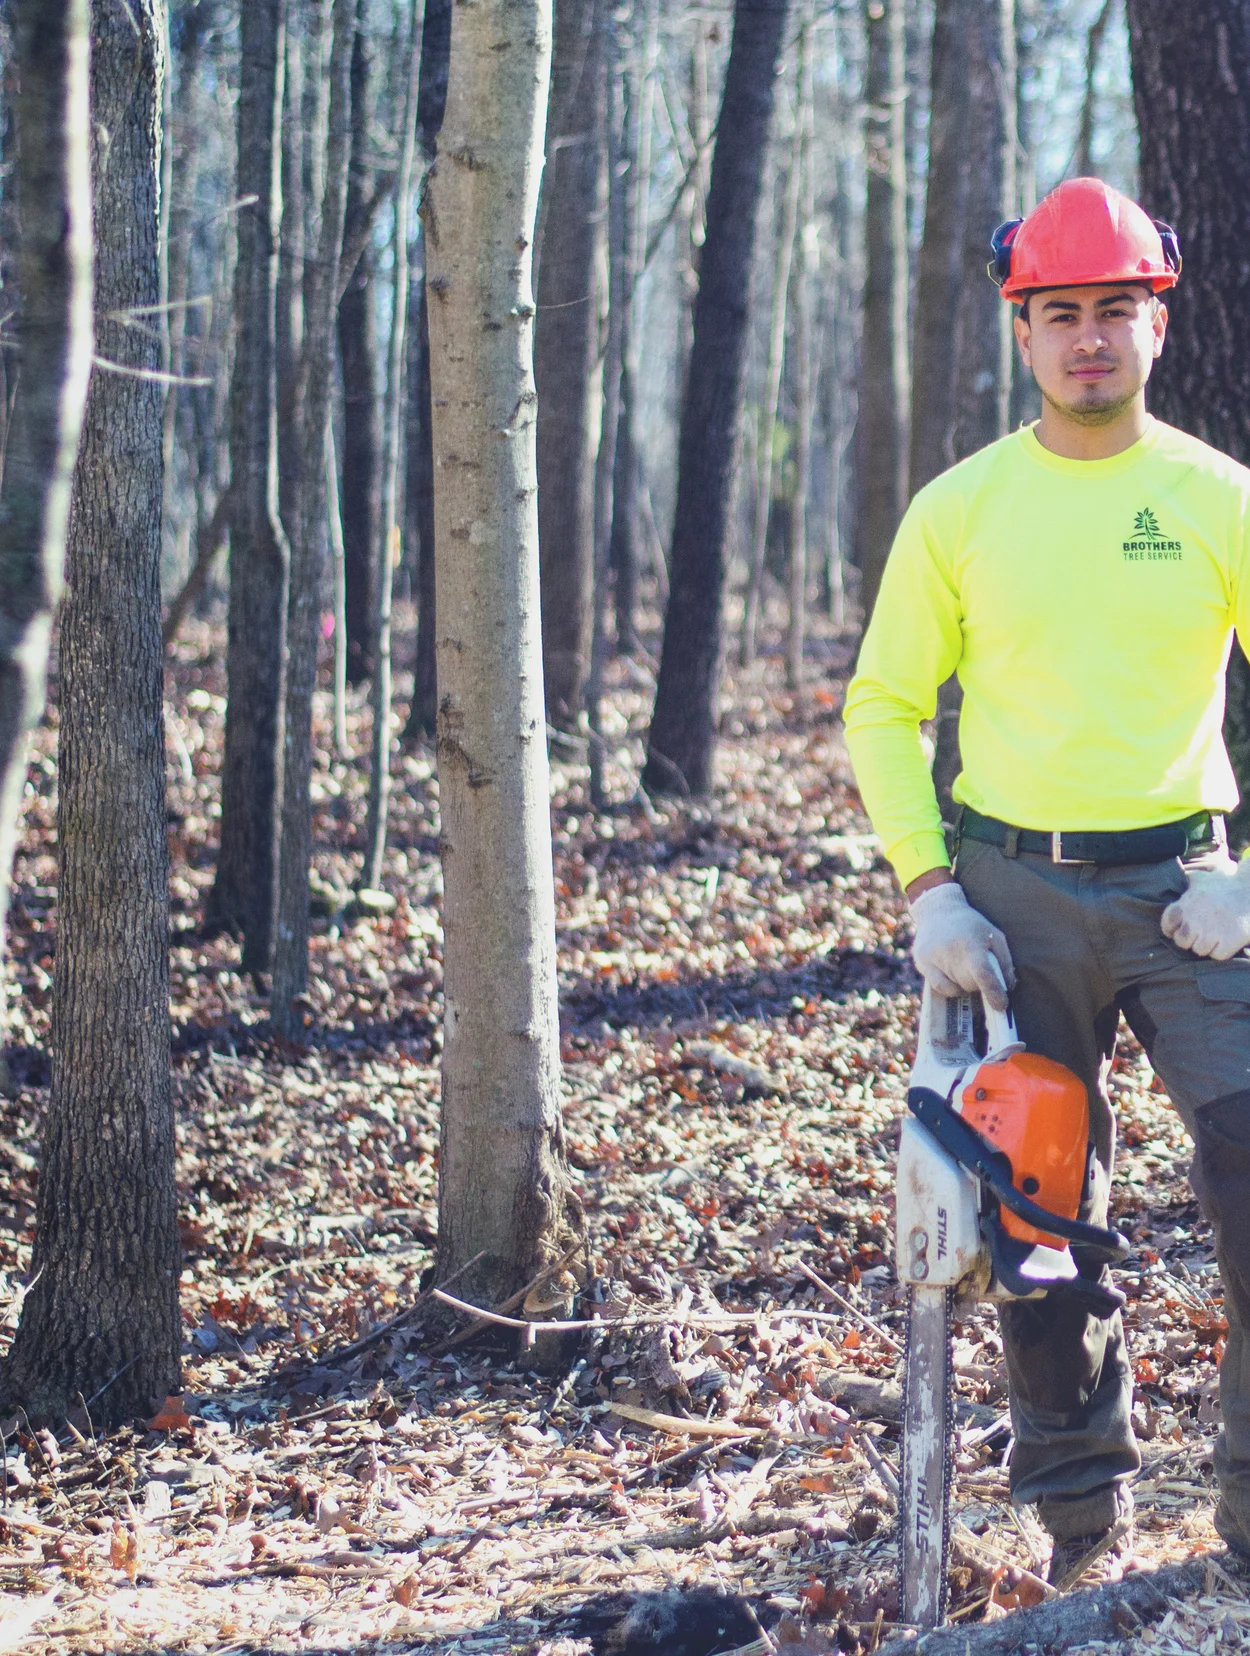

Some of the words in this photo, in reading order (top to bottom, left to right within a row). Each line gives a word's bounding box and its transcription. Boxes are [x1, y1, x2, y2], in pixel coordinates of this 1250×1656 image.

[1123, 541, 1182, 551] BROTHERS
[1123, 552, 1145, 561] TREE
[1148, 552, 1183, 561] SERVICE
[937, 1206, 947, 1261] STIHL
